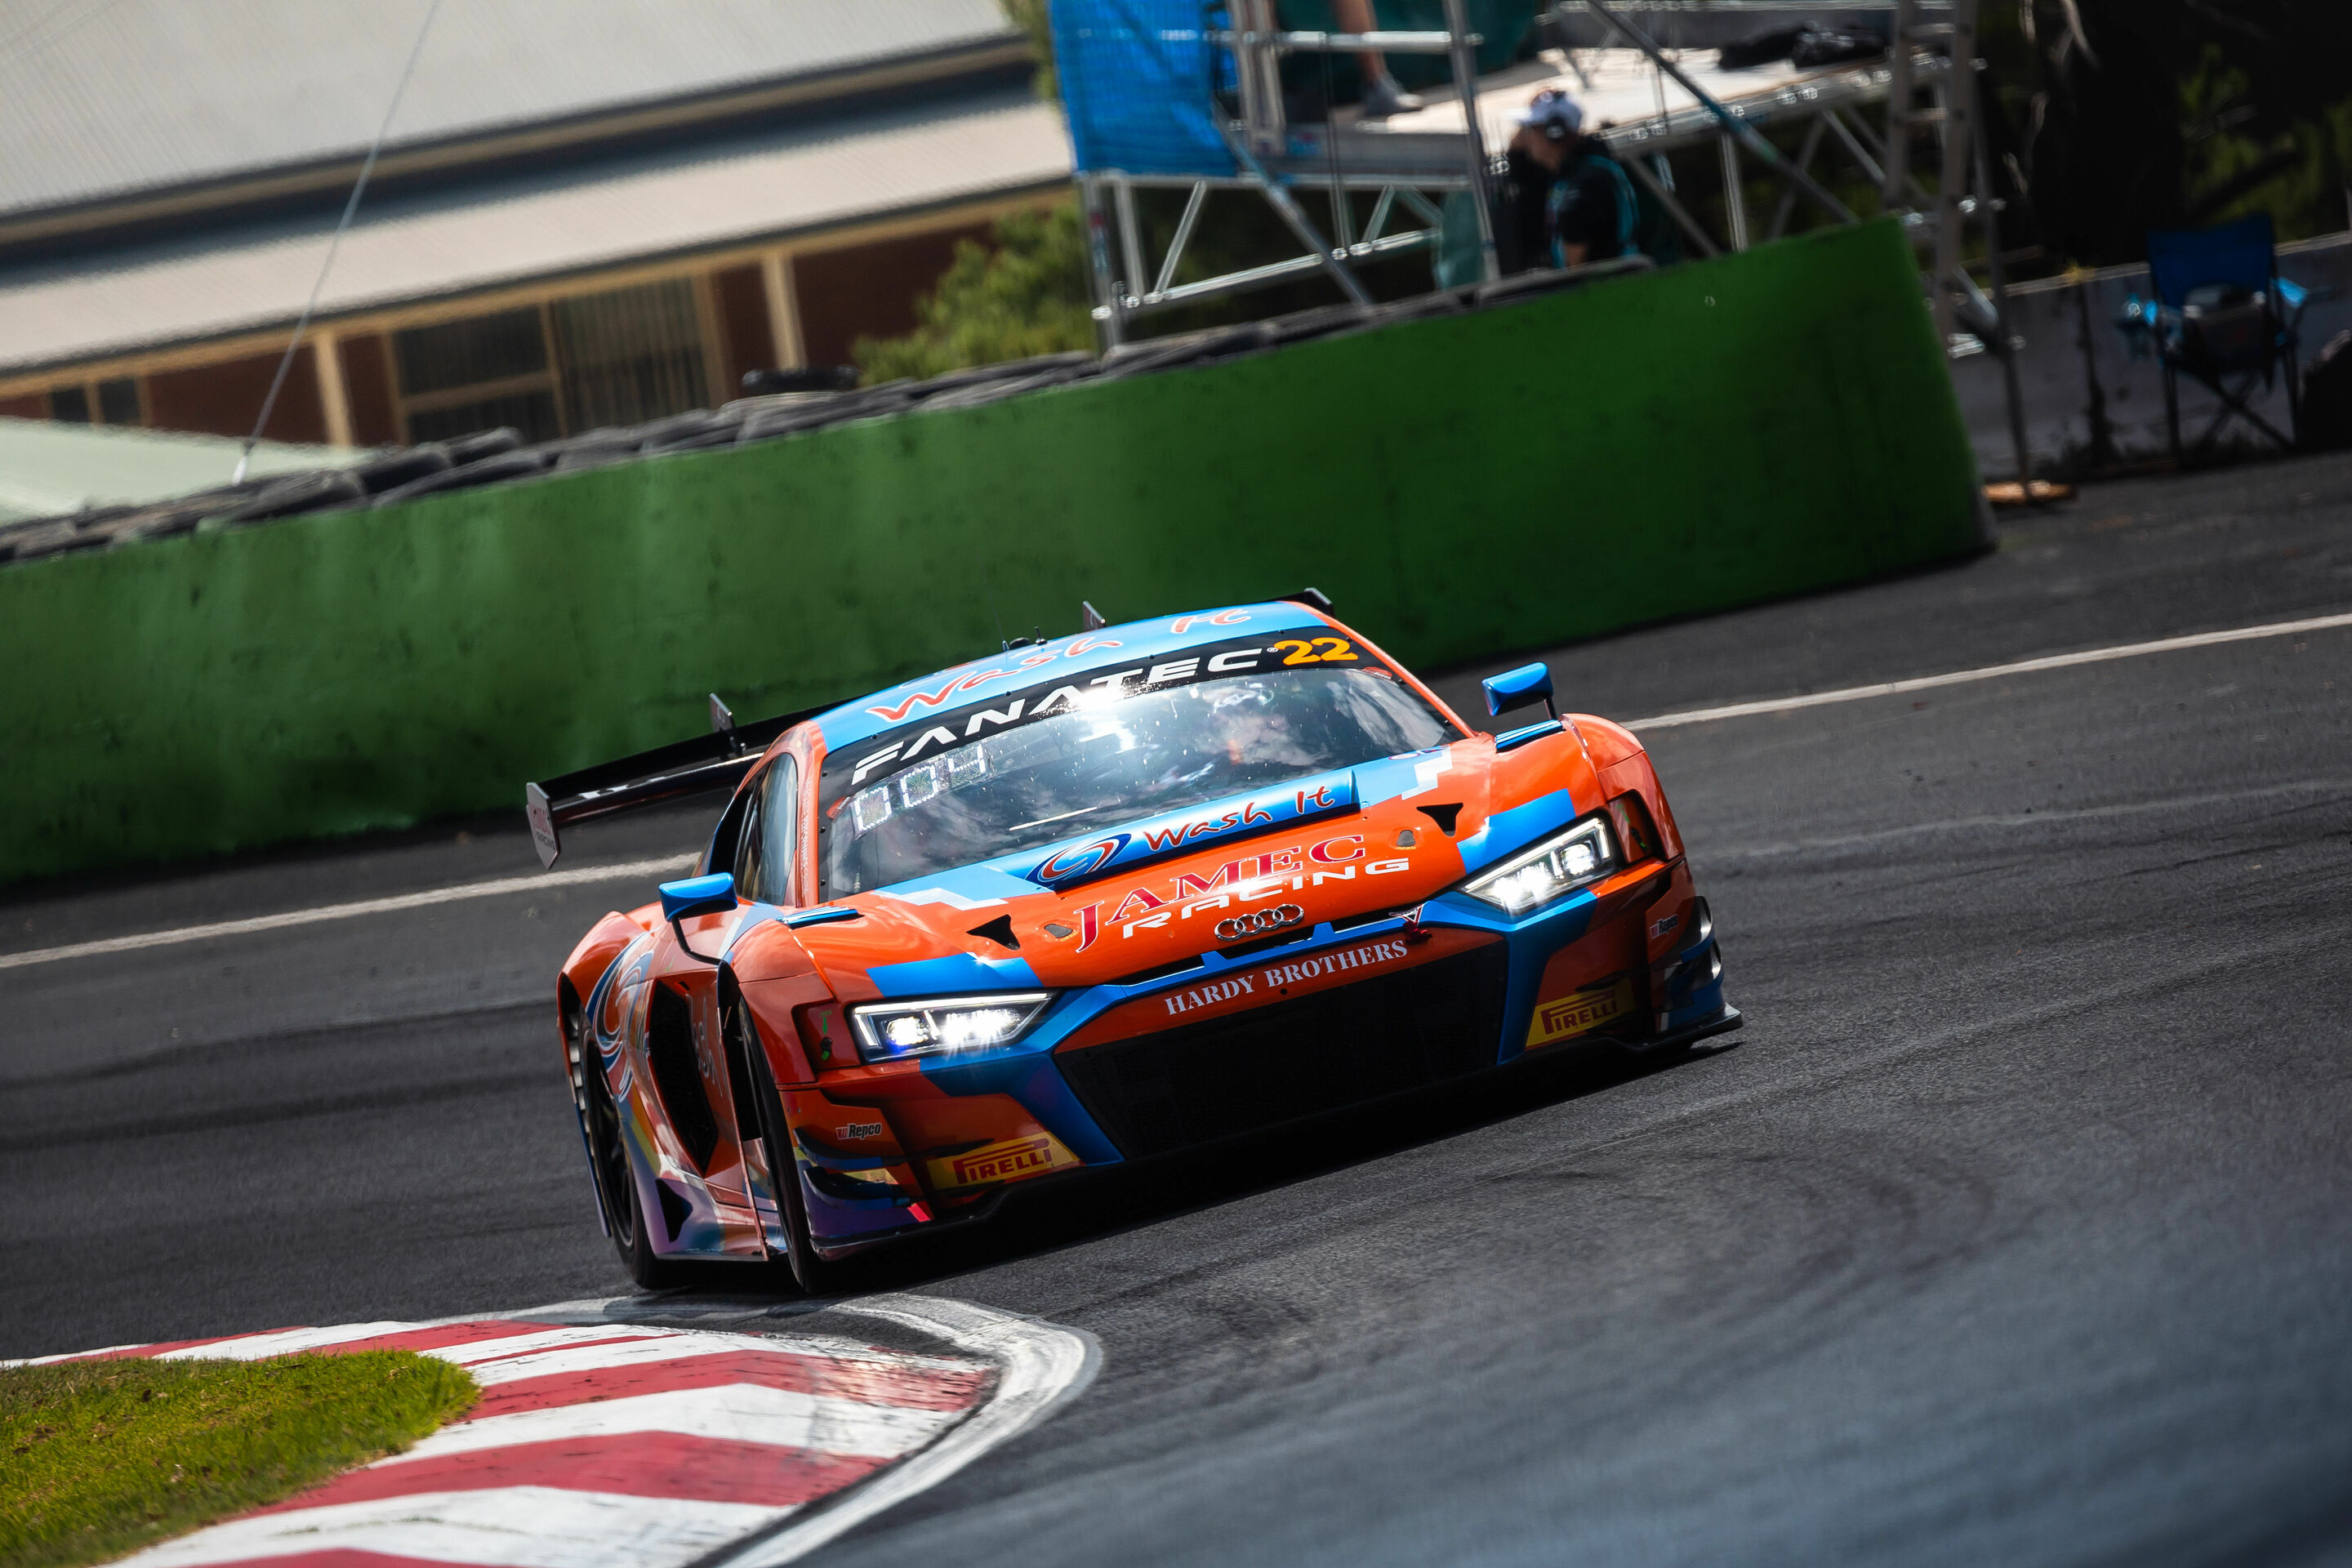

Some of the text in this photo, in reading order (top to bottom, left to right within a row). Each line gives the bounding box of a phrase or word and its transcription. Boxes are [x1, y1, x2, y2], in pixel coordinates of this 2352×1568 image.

[866, 608, 1252, 722] Wash It
[1273, 637, 1359, 666] 22
[1143, 785, 1334, 851] Wash It
[1073, 835, 1365, 953] JAMEC
[1122, 858, 1410, 939] RACING
[1165, 939, 1408, 1015] HARDY BROTHERS
[1540, 989, 1617, 1036] PIRELLI
[849, 1123, 882, 1140] Repco
[953, 1138, 1052, 1184] PIRELLI
